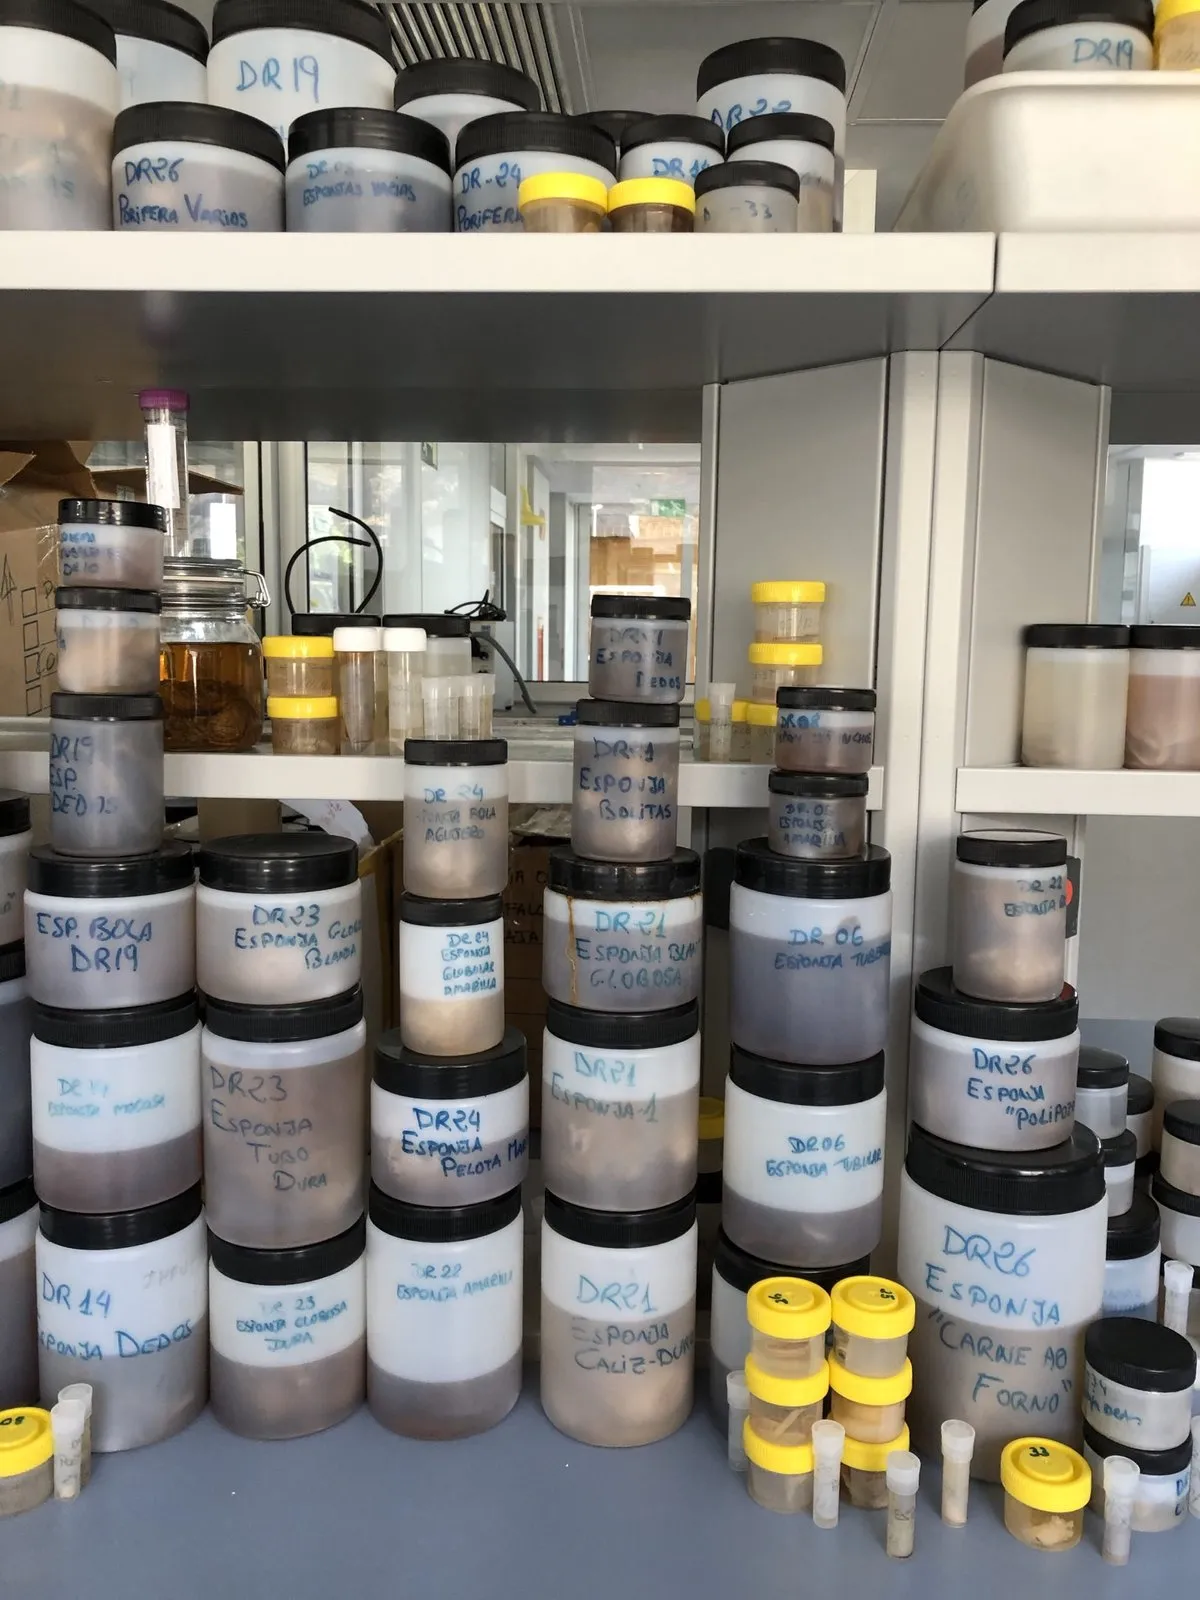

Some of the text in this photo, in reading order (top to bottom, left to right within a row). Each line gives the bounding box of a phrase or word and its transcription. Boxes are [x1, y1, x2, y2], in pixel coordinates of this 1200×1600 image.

[1073, 37, 1134, 69] DR19
[124, 157, 186, 187] DR26
[234, 927, 319, 949] ESPONJA
[71, 943, 138, 972] DR19
[972, 1047, 1037, 1075] DR26
[210, 1066, 288, 1103] DR23
[211, 1098, 313, 1137] ESPONJA
[413, 1107, 481, 1132] DR24
[401, 1130, 483, 1157] ESPONJA
[943, 1225, 1036, 1277] DR26
[925, 1262, 1061, 1327] ESPONJA
[1029, 1446, 1050, 1457] 33
